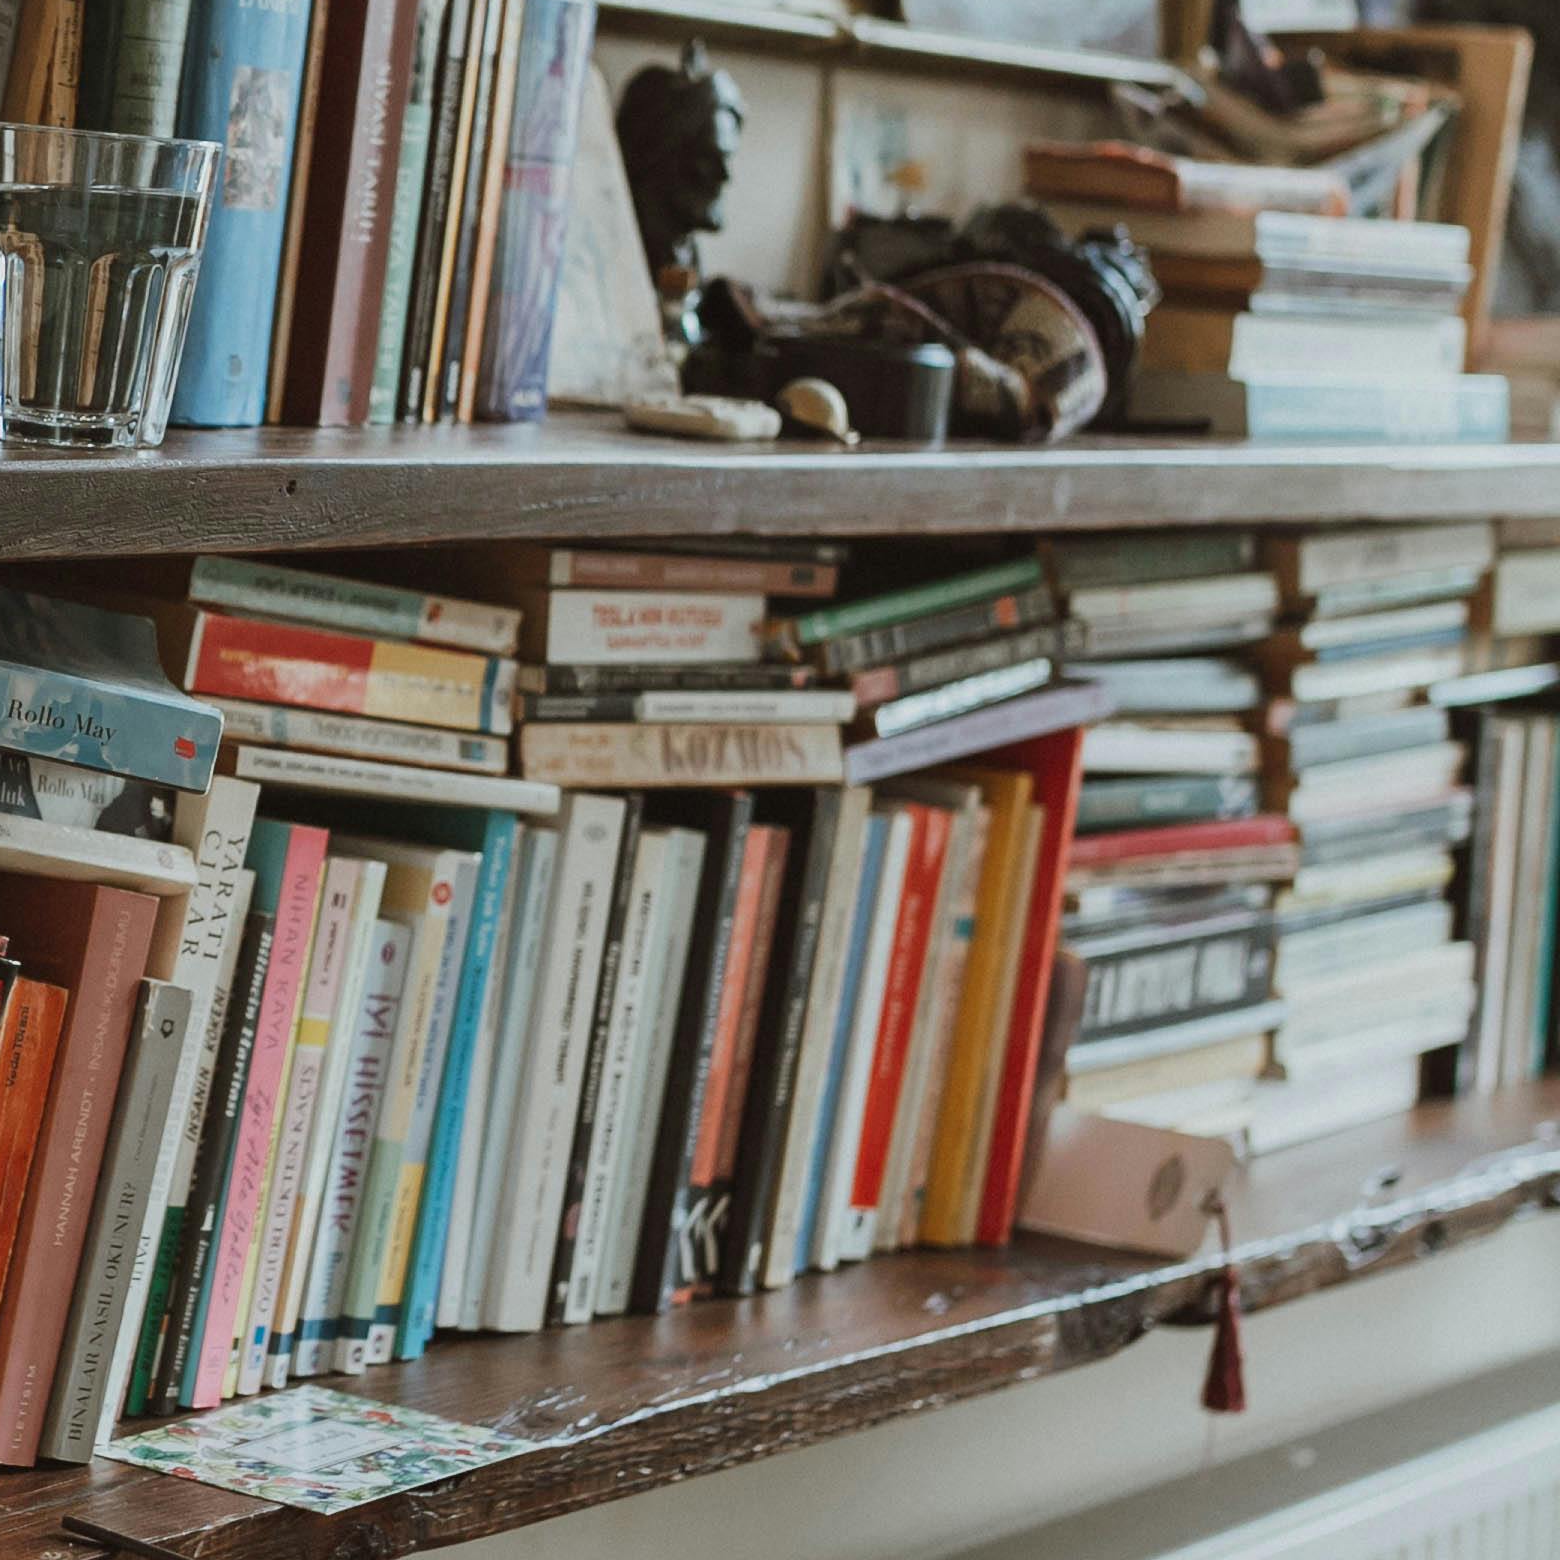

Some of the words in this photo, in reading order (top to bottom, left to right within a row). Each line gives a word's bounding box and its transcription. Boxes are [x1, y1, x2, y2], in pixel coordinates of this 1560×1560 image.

[7, 699, 66, 730] Rollo
[74, 714, 119, 746] May
[7, 756, 27, 774] ve
[36, 774, 75, 800] Rollo
[179, 828, 222, 958] CILAR
[201, 833, 245, 962] YARATI
[263, 978, 289, 1052] KAYA
[52, 1165, 79, 1247] HANNAH
[70, 1088, 94, 1163] ARENDT
[66, 1349, 100, 1442] BİNALAR
[88, 1283, 115, 1346] NASIL
[103, 1180, 138, 1280] OKUNUR?
